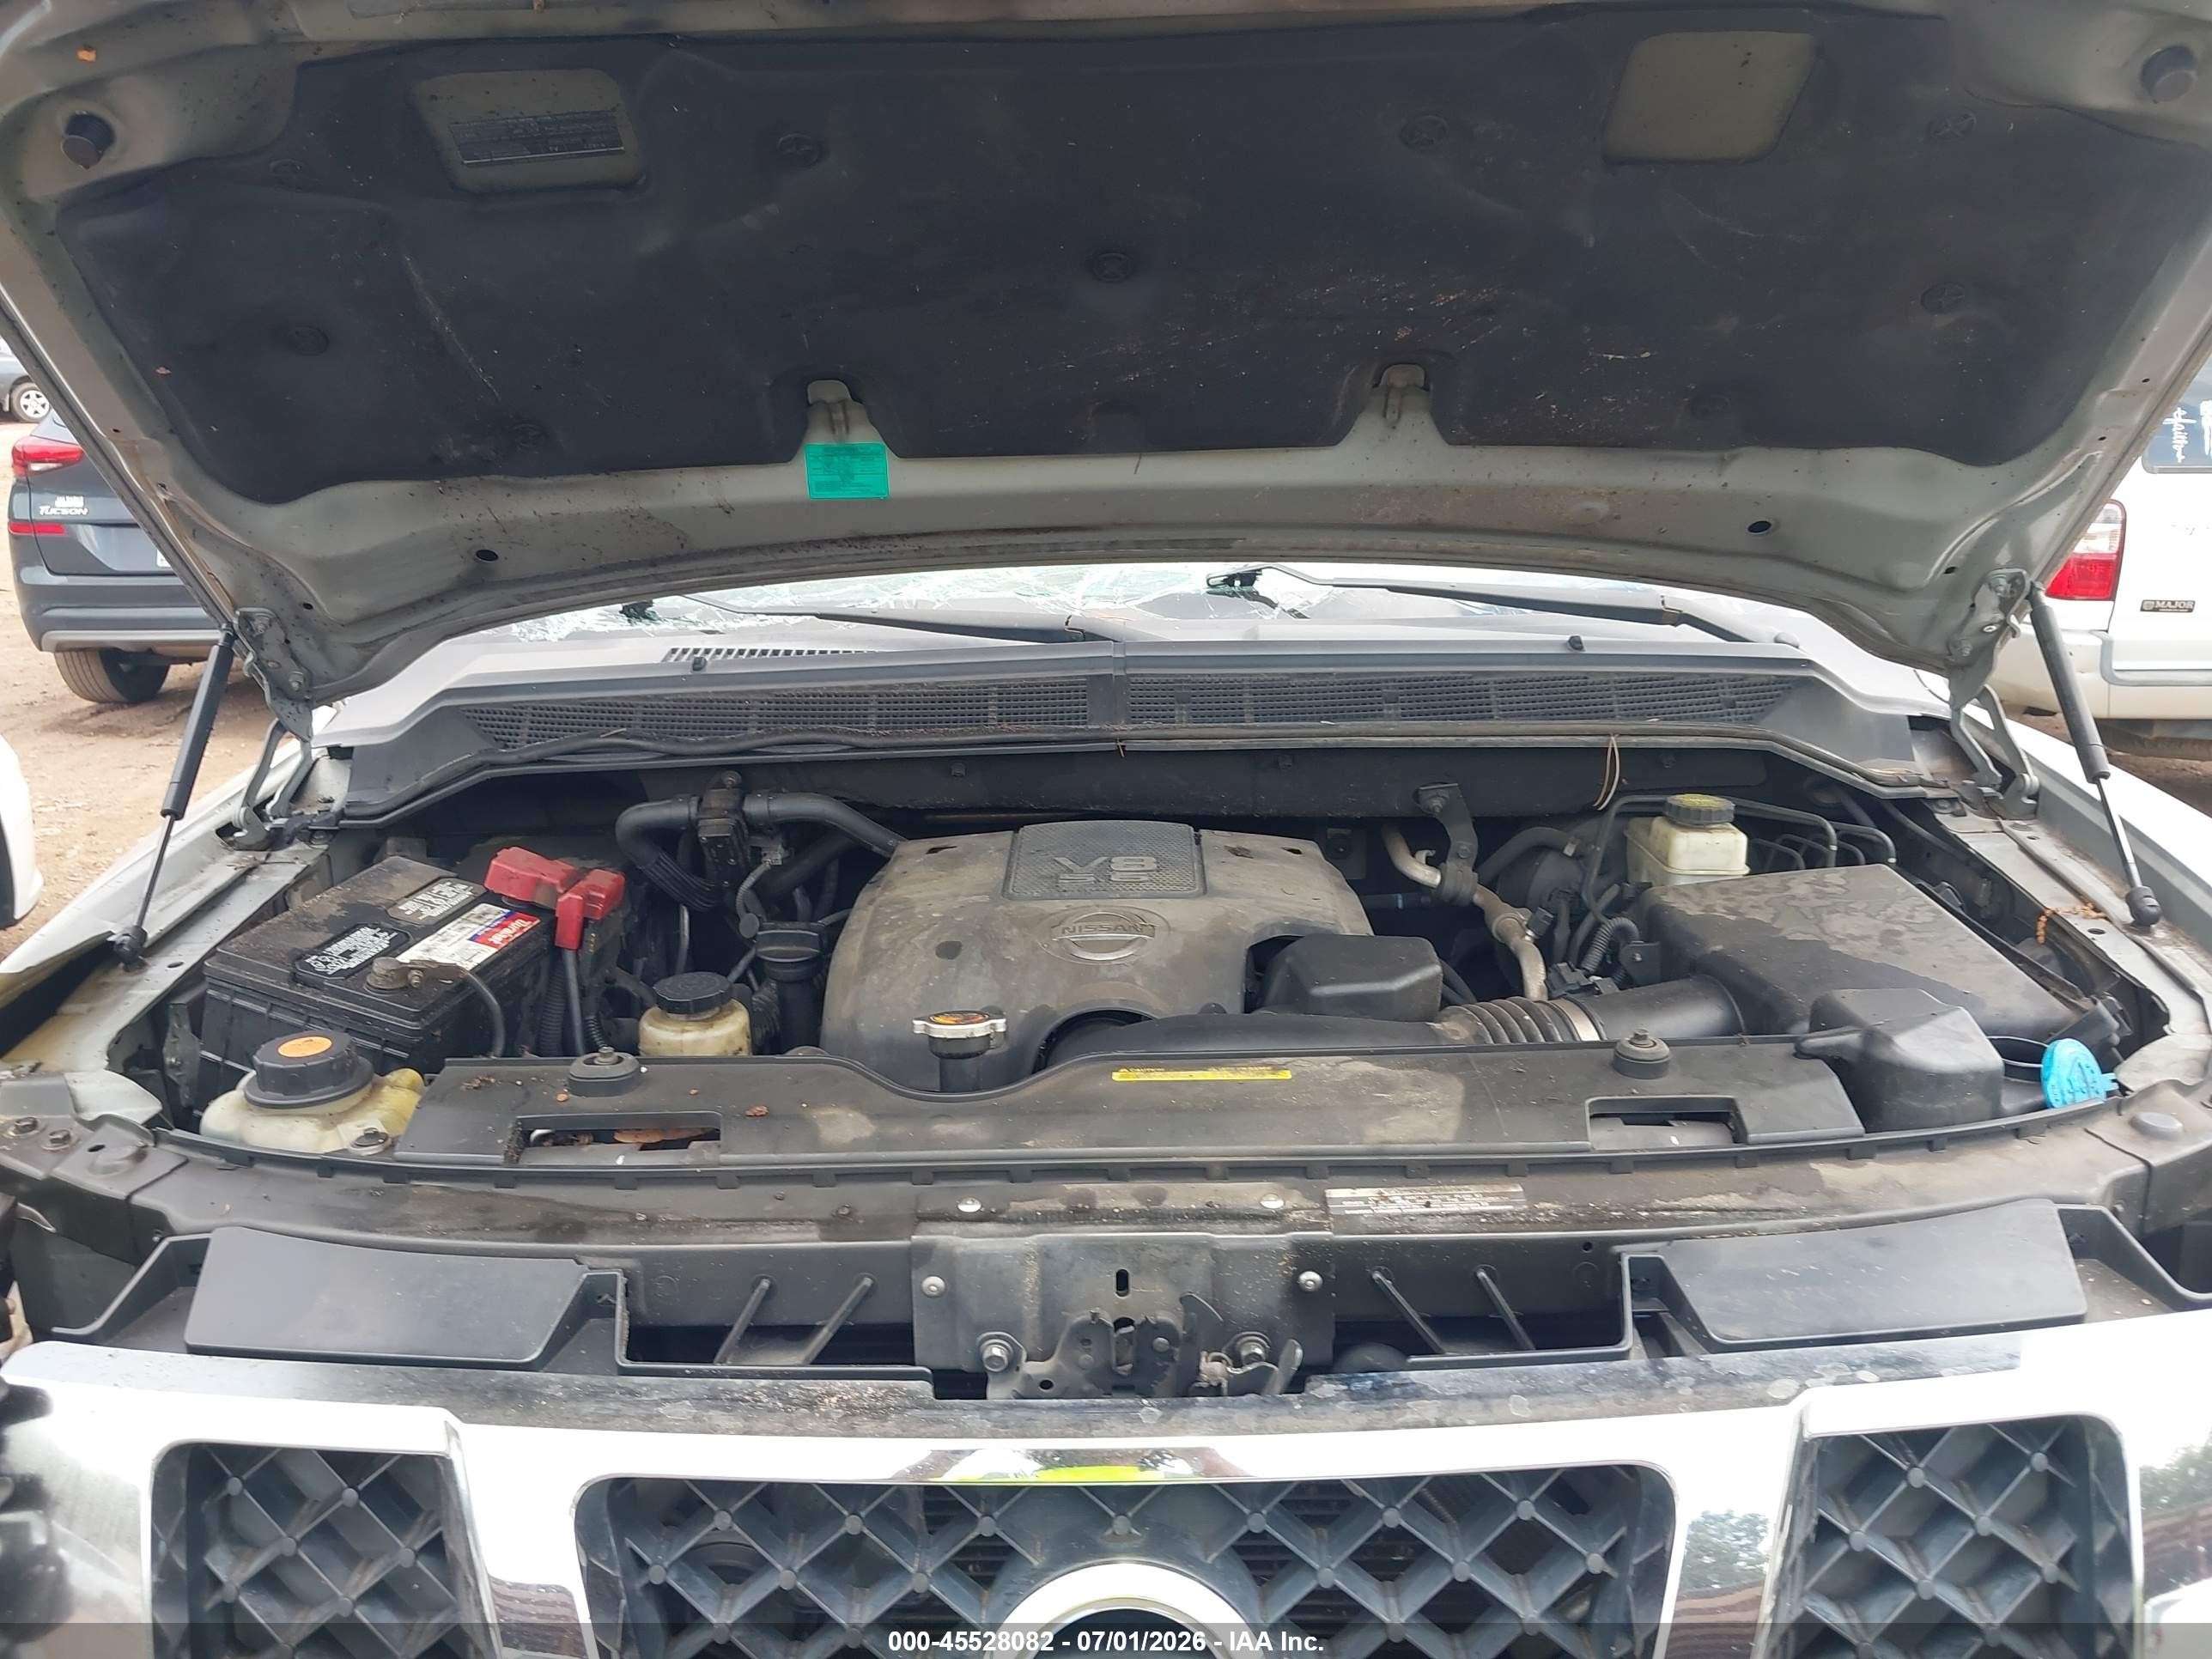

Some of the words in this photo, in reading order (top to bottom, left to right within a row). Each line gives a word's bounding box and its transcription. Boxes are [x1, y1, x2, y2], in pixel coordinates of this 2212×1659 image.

[2156, 600, 2193, 609] MAJOR
[1054, 856, 1157, 872] V8
[1061, 924, 1144, 935] NISSAN
